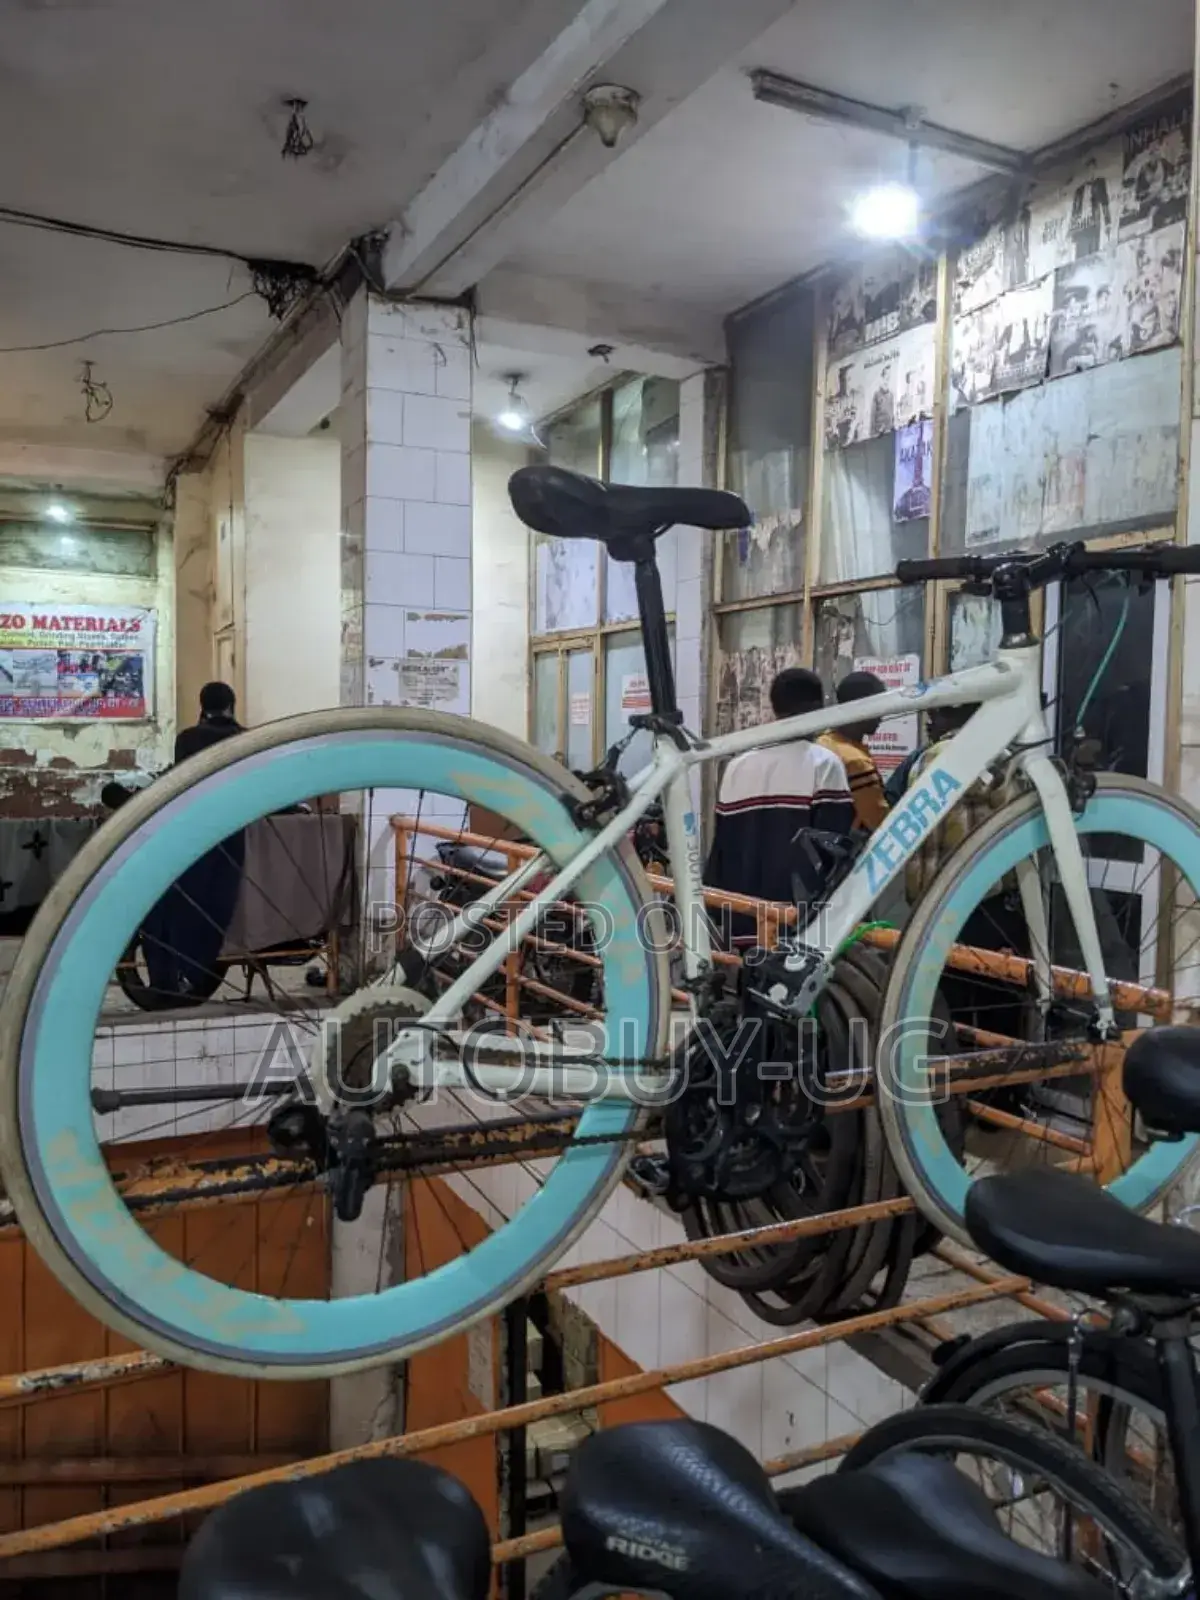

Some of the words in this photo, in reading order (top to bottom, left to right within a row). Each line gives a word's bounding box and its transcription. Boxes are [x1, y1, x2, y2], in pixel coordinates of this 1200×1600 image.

[32, 614, 142, 632] MATERIALS
[853, 768, 963, 896] ZEBRA
[605, 1535, 690, 1571] RIDGE
